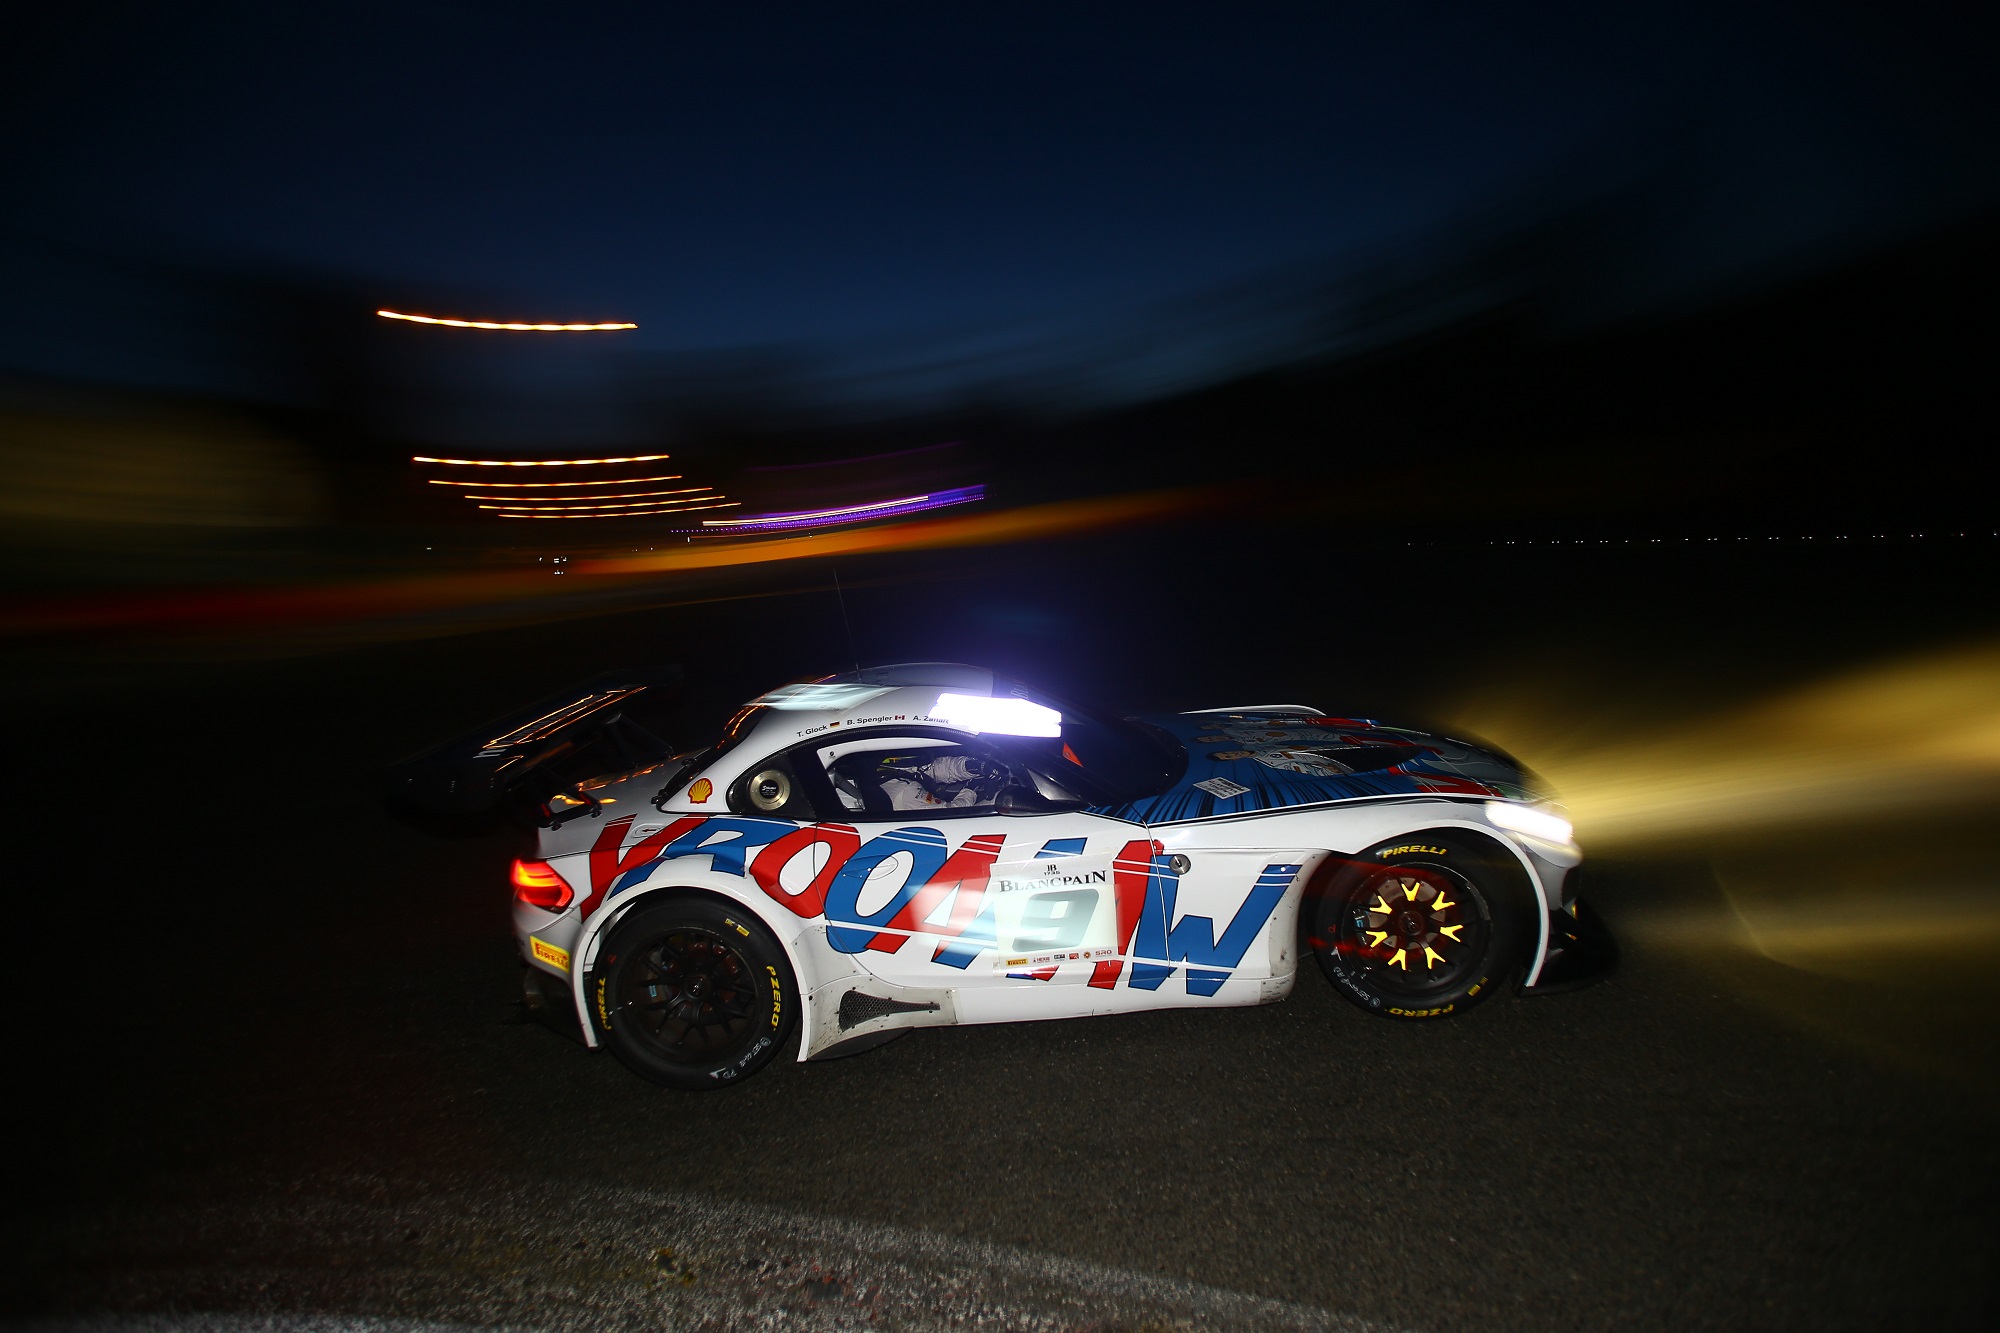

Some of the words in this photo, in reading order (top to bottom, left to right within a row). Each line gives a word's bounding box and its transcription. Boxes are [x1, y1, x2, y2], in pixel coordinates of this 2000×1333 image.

[857, 716, 893, 725] Spengler
[805, 725, 828, 735] Glock
[1383, 844, 1447, 859] PIRELLI
[1011, 887, 1100, 953] 9
